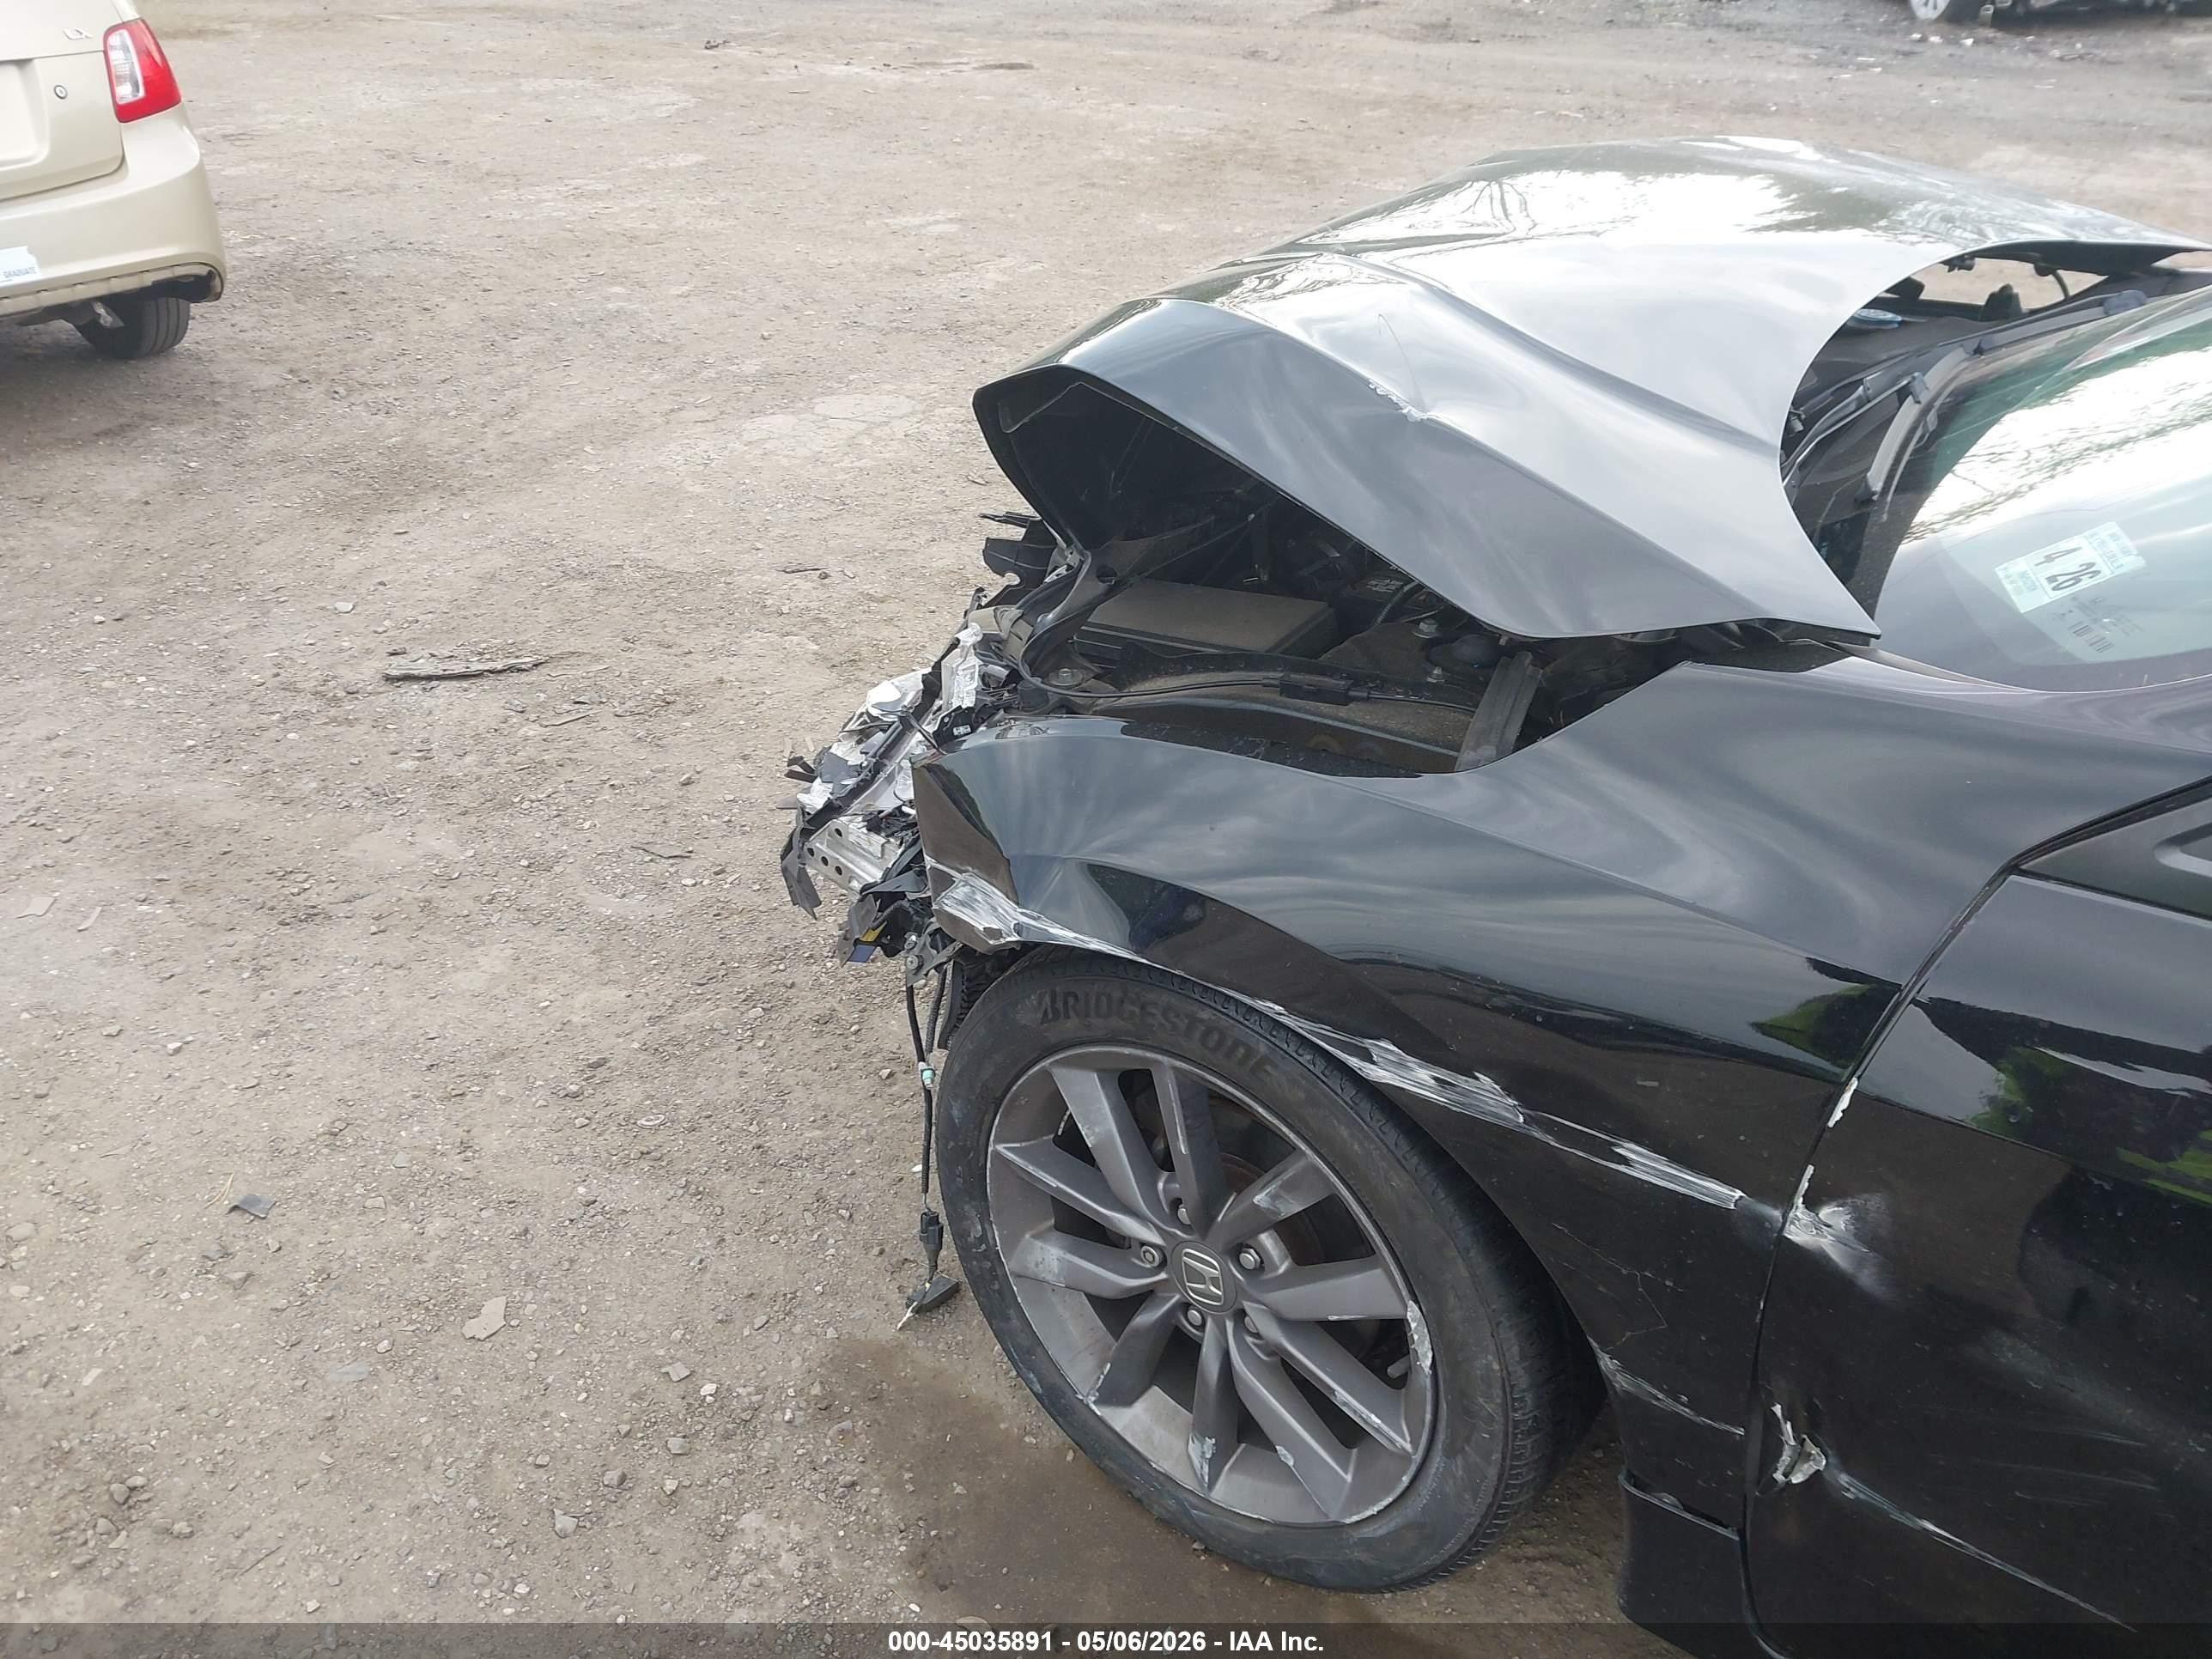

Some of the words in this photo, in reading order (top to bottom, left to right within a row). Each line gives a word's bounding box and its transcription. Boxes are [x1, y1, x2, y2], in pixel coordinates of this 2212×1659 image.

[2034, 545, 2083, 567] 4
[2045, 561, 2102, 592] 26
[1038, 988, 1279, 1079] BRIDGESTONE
